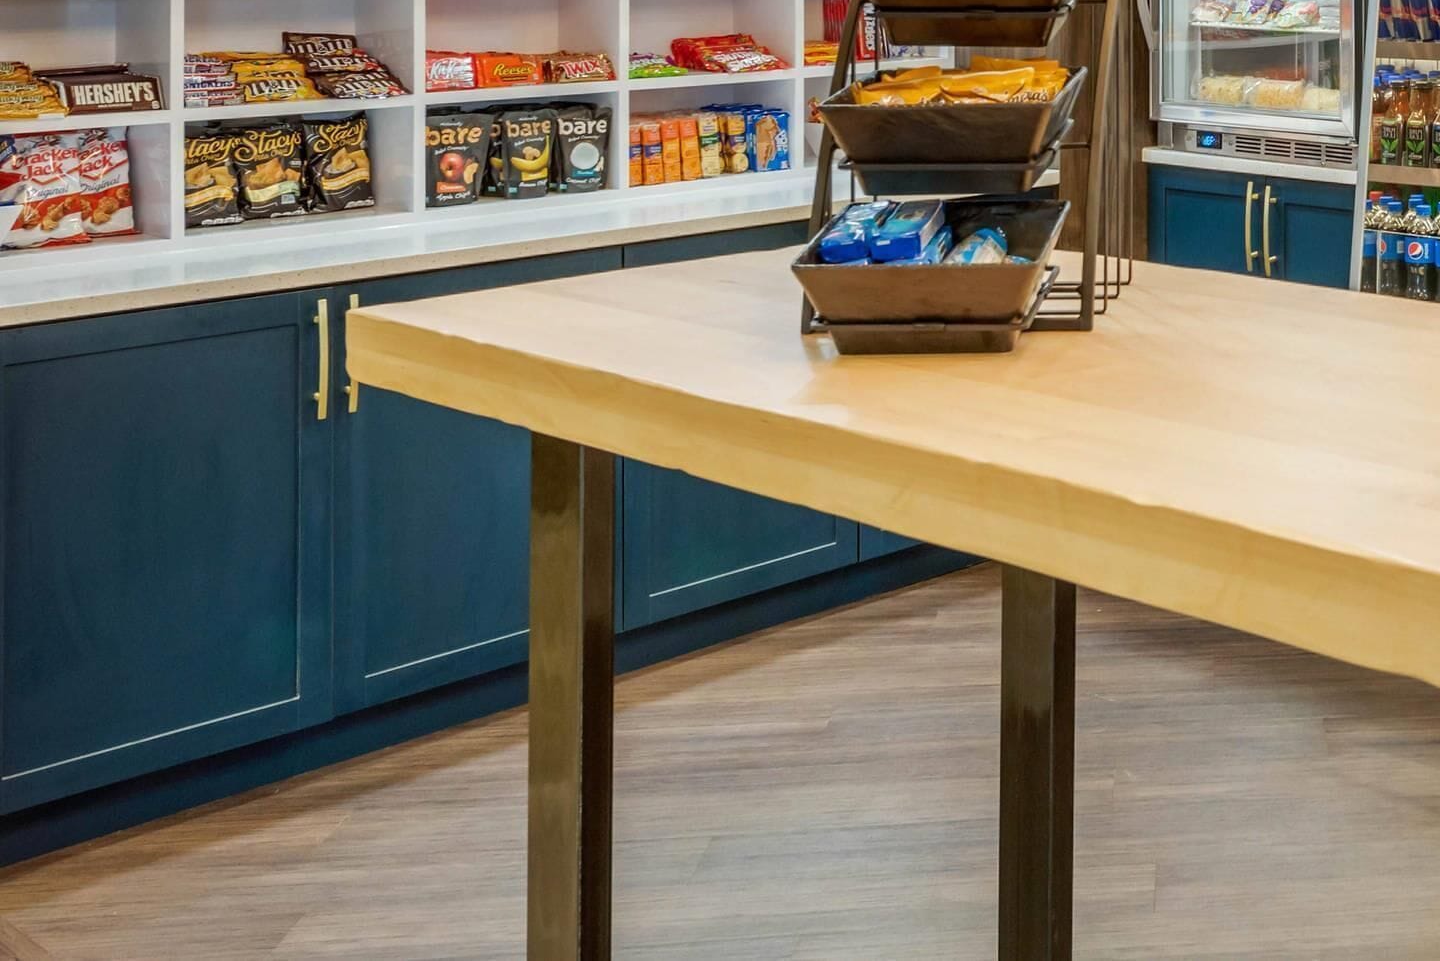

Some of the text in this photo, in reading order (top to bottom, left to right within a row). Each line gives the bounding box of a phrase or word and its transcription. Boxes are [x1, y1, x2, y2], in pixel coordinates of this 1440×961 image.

[559, 59, 601, 79] TWIX
[75, 81, 155, 106] HERSHEY'S
[425, 125, 484, 147] bare
[505, 119, 550, 138] bare
[557, 117, 608, 136] bare
[234, 129, 301, 163] Stacy's
[11, 147, 80, 170] Cracker
[21, 162, 65, 181] Jack
